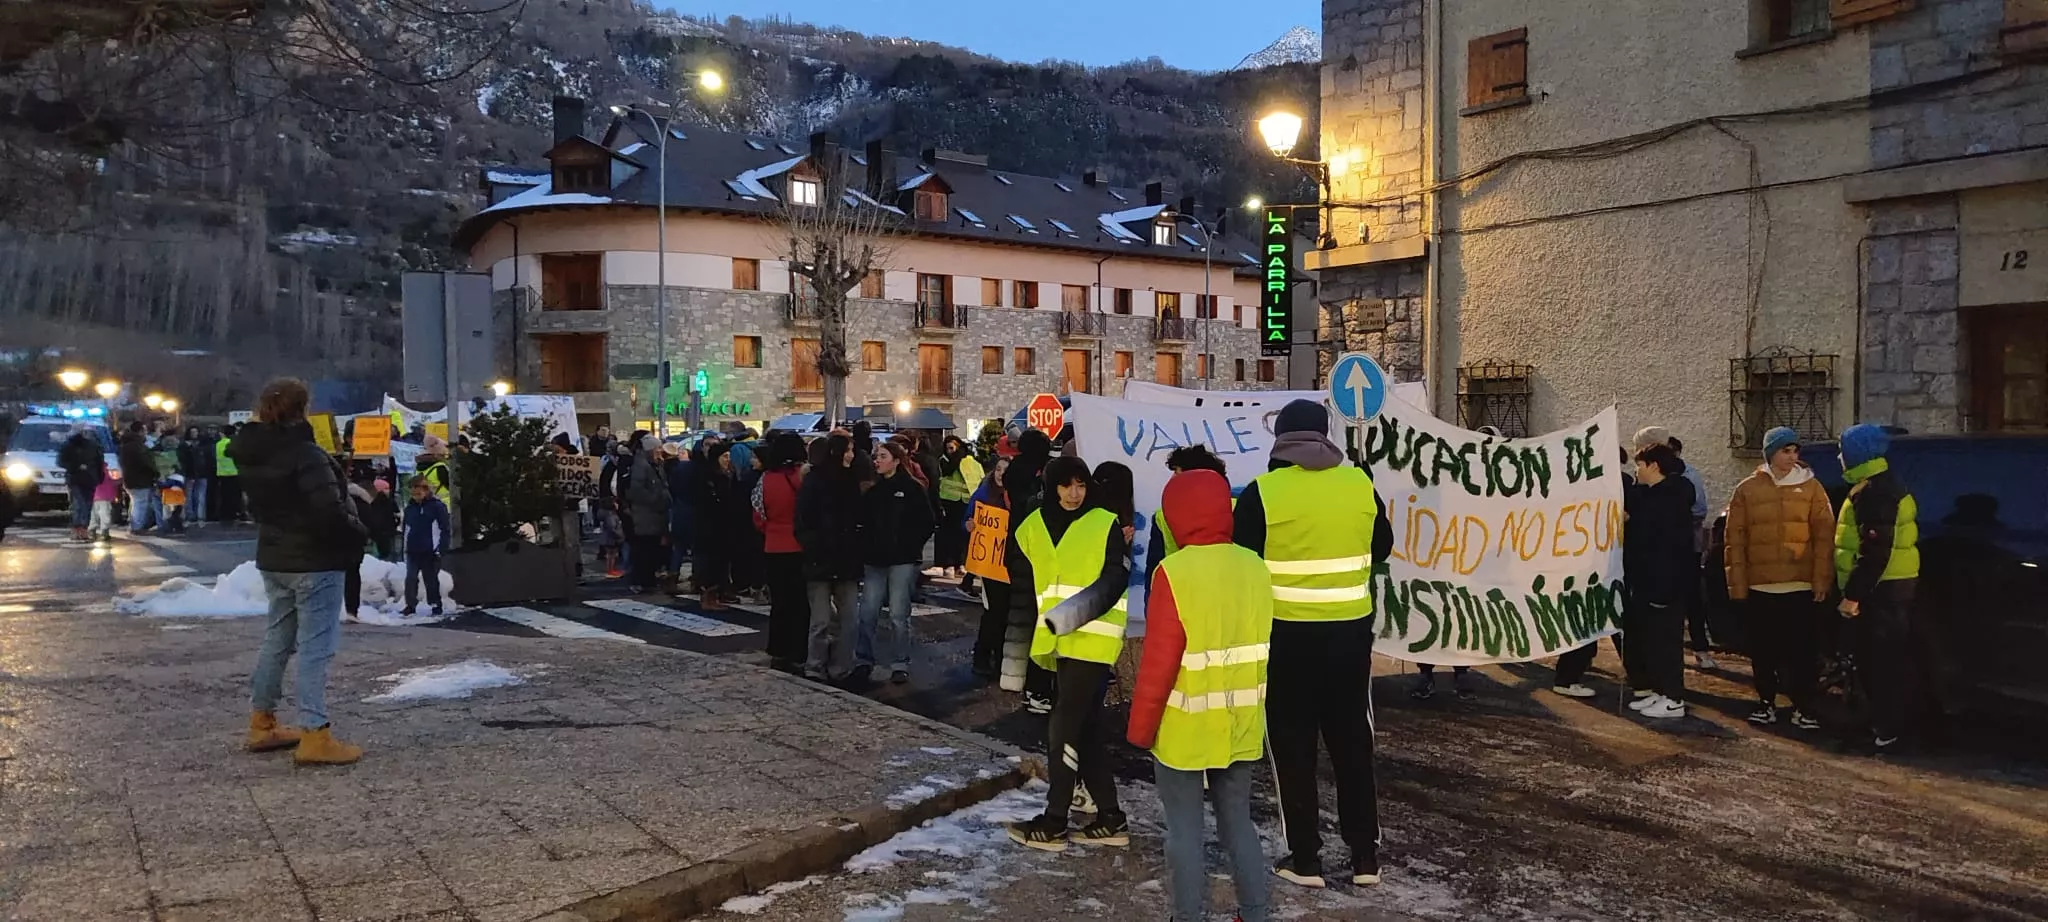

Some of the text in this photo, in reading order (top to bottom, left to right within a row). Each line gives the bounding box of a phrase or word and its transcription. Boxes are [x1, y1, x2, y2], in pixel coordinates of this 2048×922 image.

[1267, 211, 1286, 341] LA PARRILLA
[1999, 250, 2028, 271] 12
[1030, 408, 1062, 428] STOP
[1116, 415, 1260, 461] VALLE
[1563, 423, 1604, 484] DE
[560, 468, 593, 484] IDOS
[991, 537, 1006, 567] M
[1388, 494, 1489, 576] LIDAD
[1496, 508, 1545, 562] NO
